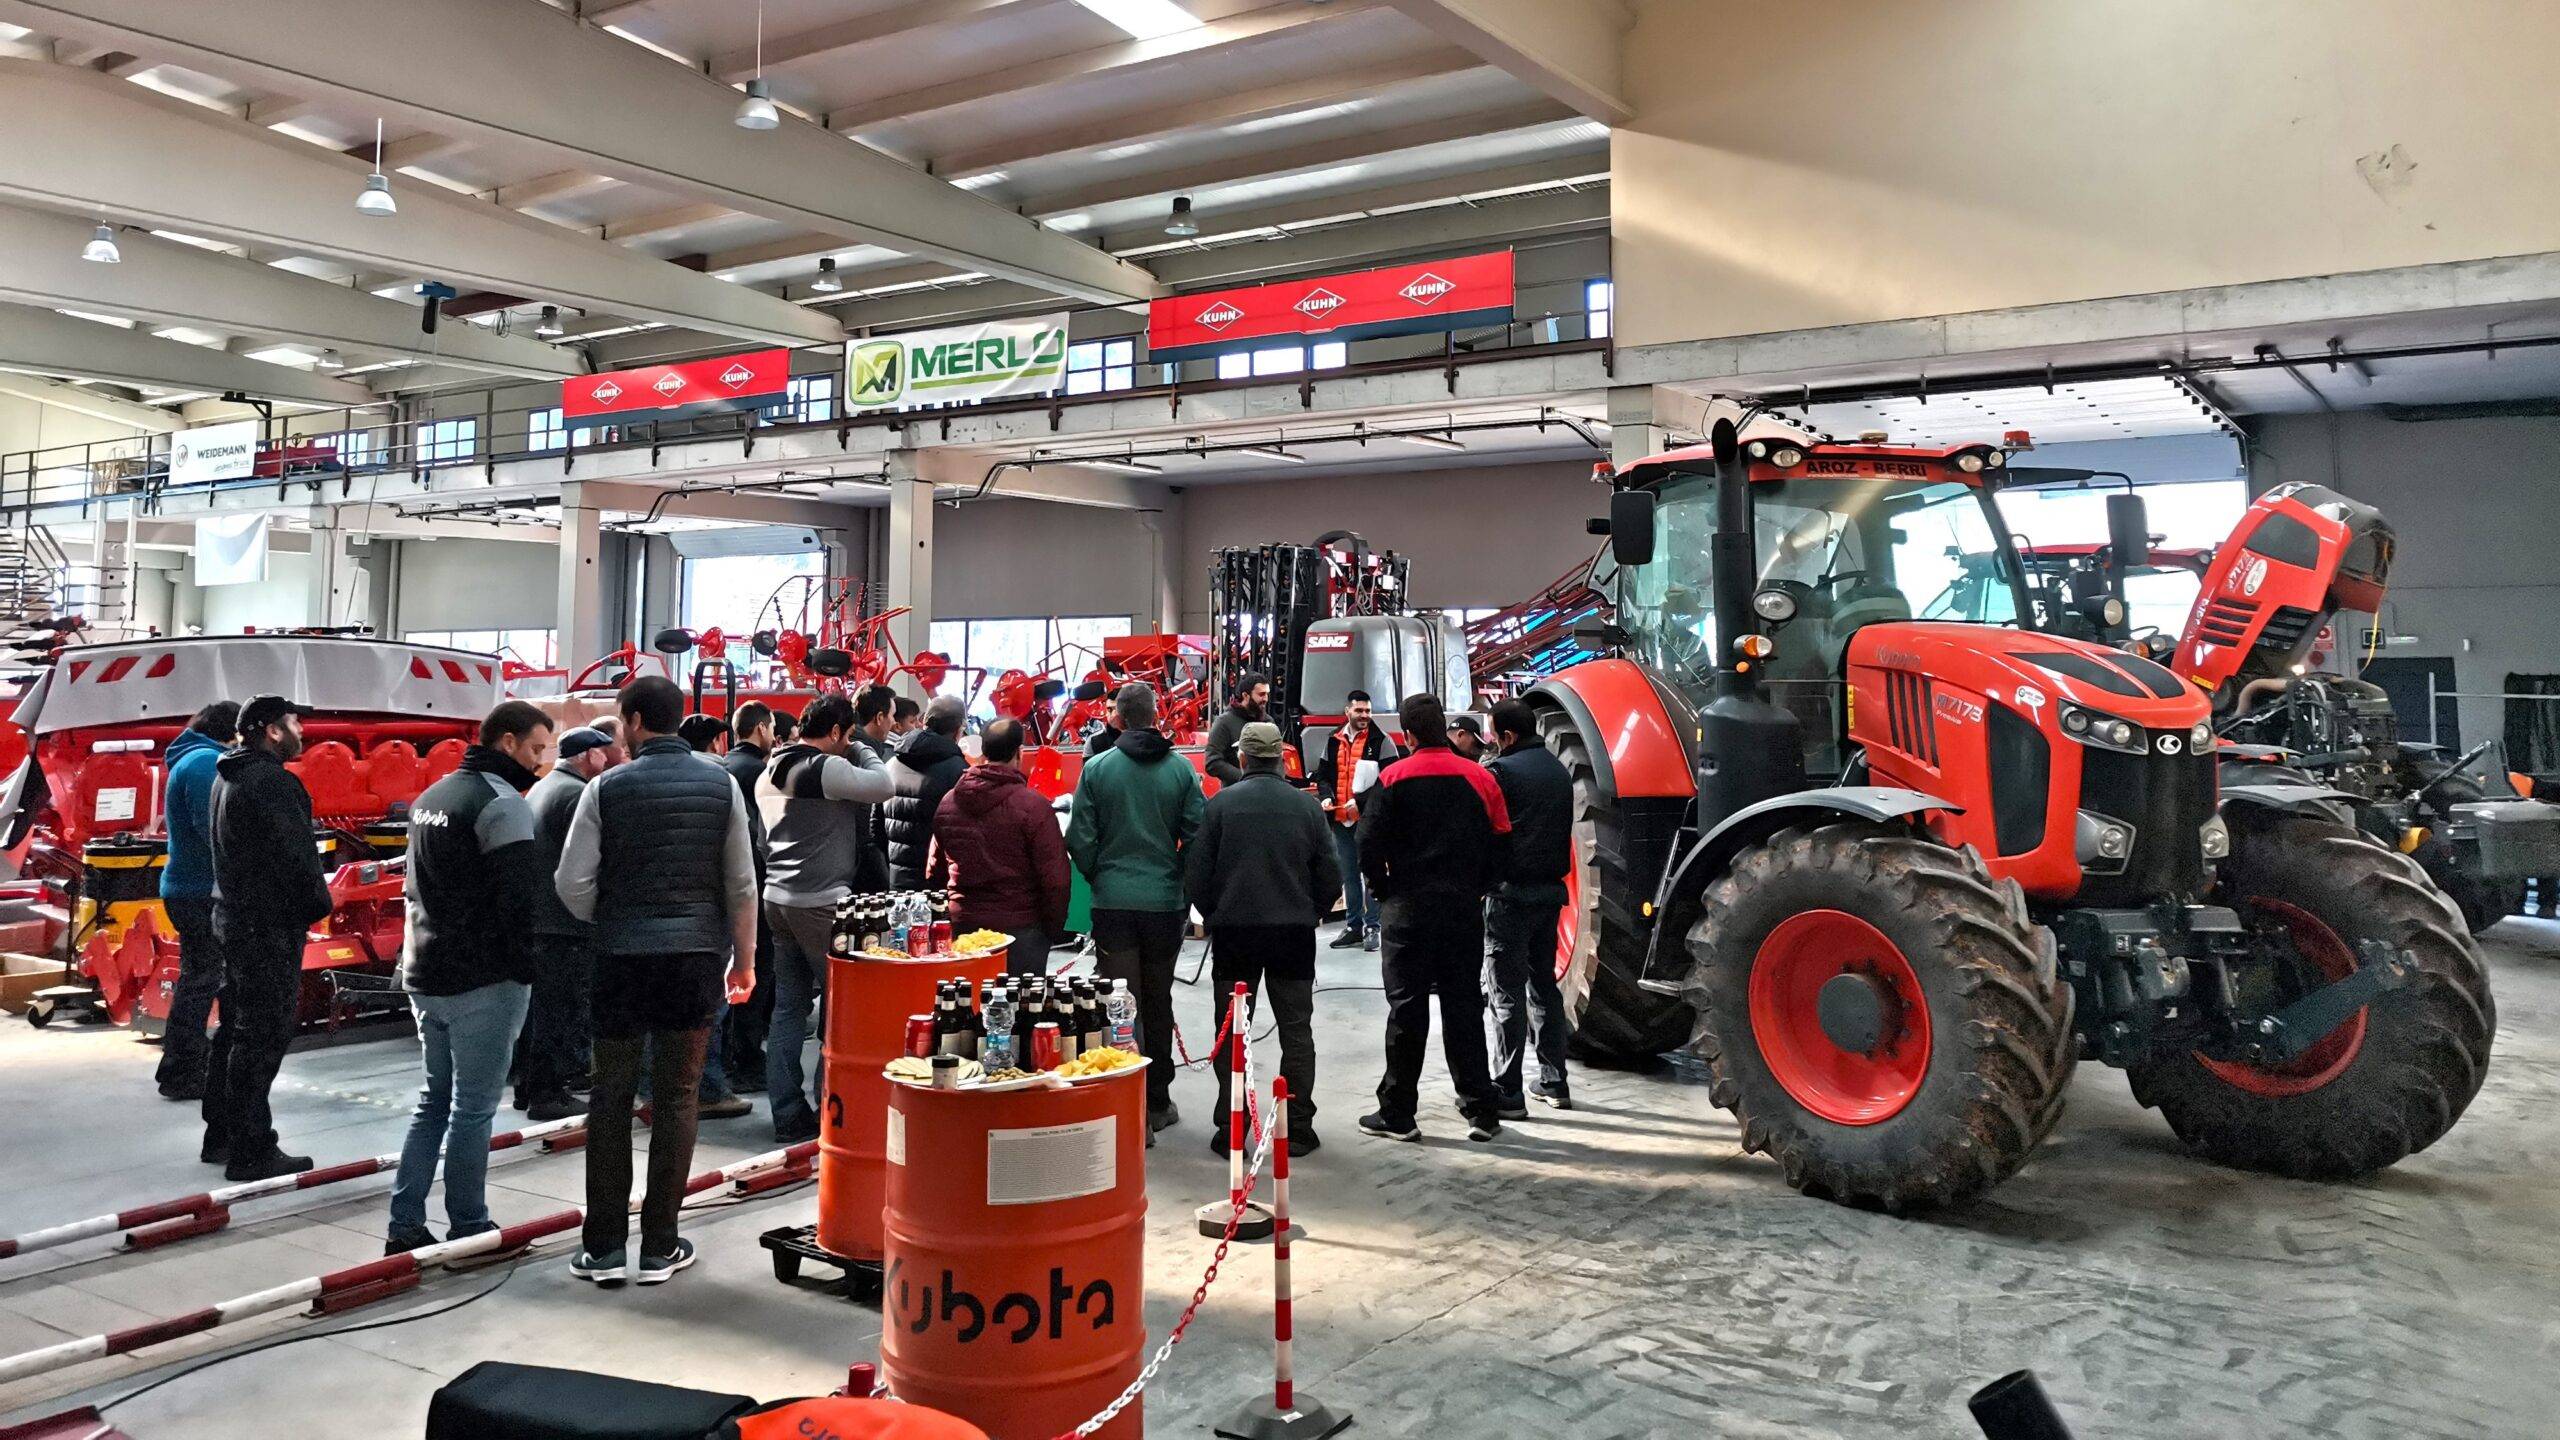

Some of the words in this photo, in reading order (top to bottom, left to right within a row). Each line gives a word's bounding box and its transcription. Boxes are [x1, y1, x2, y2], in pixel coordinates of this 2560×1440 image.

[1408, 281, 1446, 297] KUHN
[1302, 297, 1338, 311] KUHN
[1203, 310, 1237, 324] KUHN
[911, 328, 1067, 379] MERLO
[724, 371, 749, 383] KUHN
[658, 379, 681, 390] KUHN
[596, 388, 618, 398] KUHN
[197, 444, 247, 459] WEIDEMANN
[1806, 461, 1858, 474] AROZ
[1873, 461, 1927, 477] BERRI
[1307, 635, 1349, 648] SANZ
